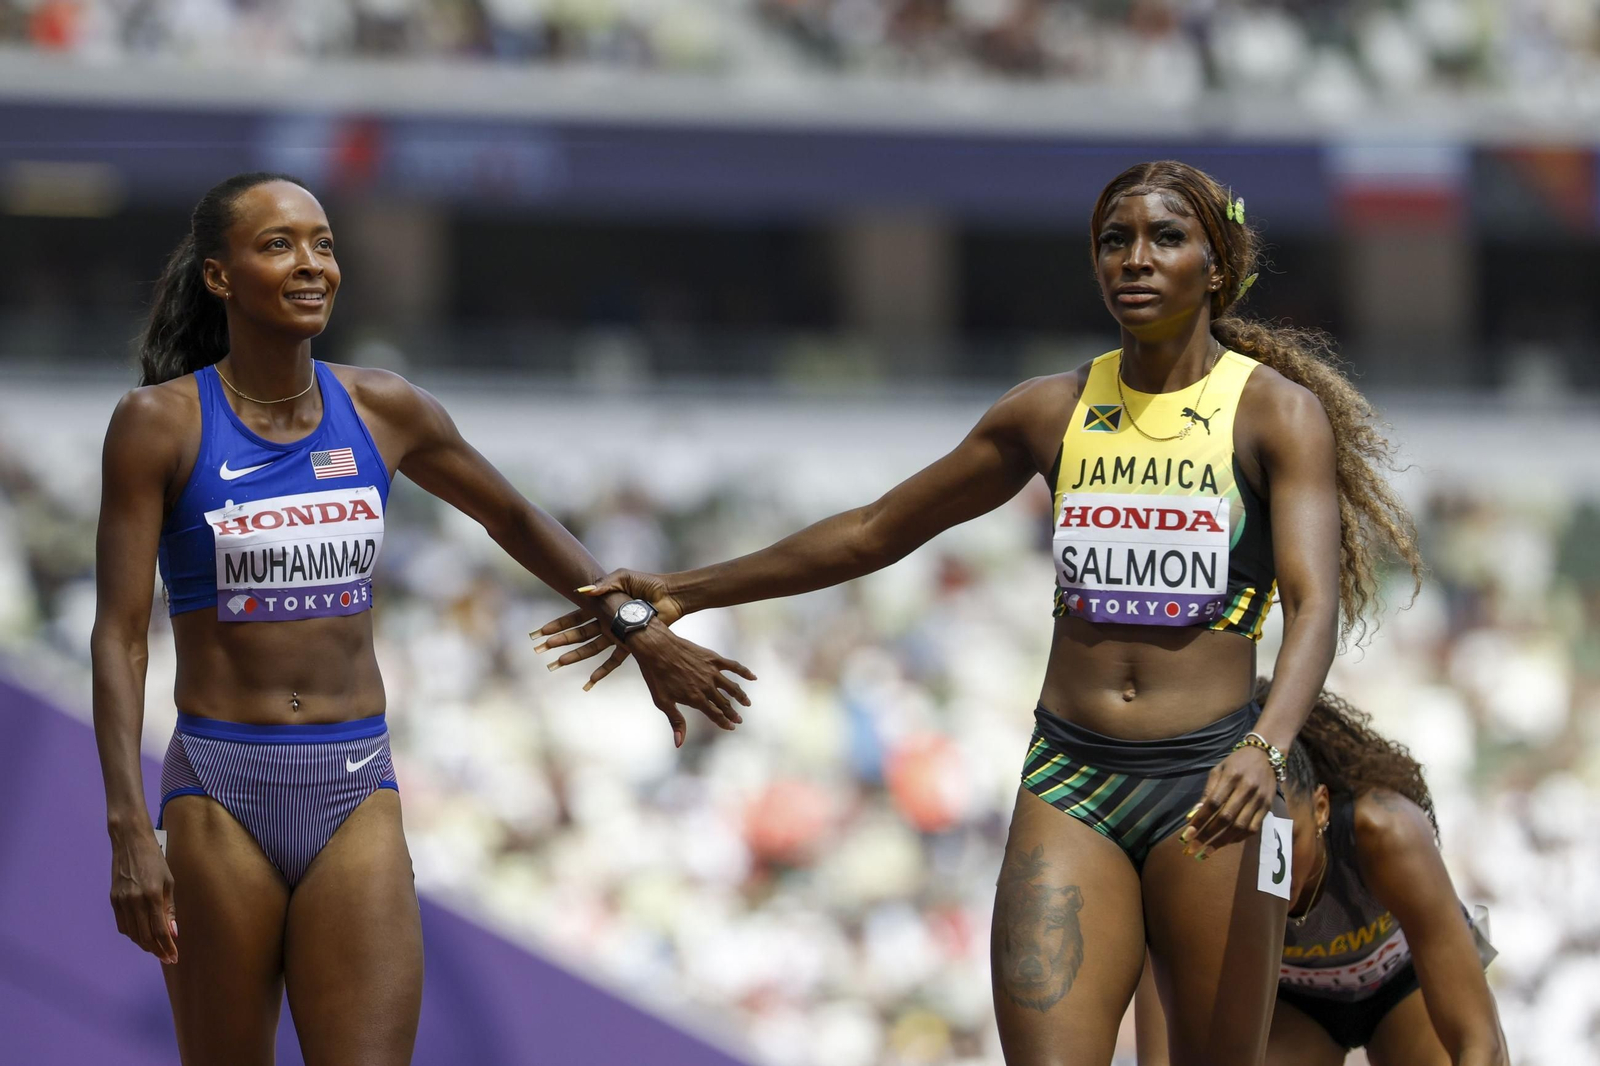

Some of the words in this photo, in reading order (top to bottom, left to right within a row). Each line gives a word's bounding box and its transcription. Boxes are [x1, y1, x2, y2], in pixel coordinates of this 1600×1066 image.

[1072, 456, 1218, 494] JAMAICA
[213, 499, 379, 536] HONDA
[1060, 506, 1224, 532] HONDA
[225, 539, 376, 584] MUHAMMAD
[1062, 546, 1217, 589] SALMON
[1272, 828, 1286, 884] 3
